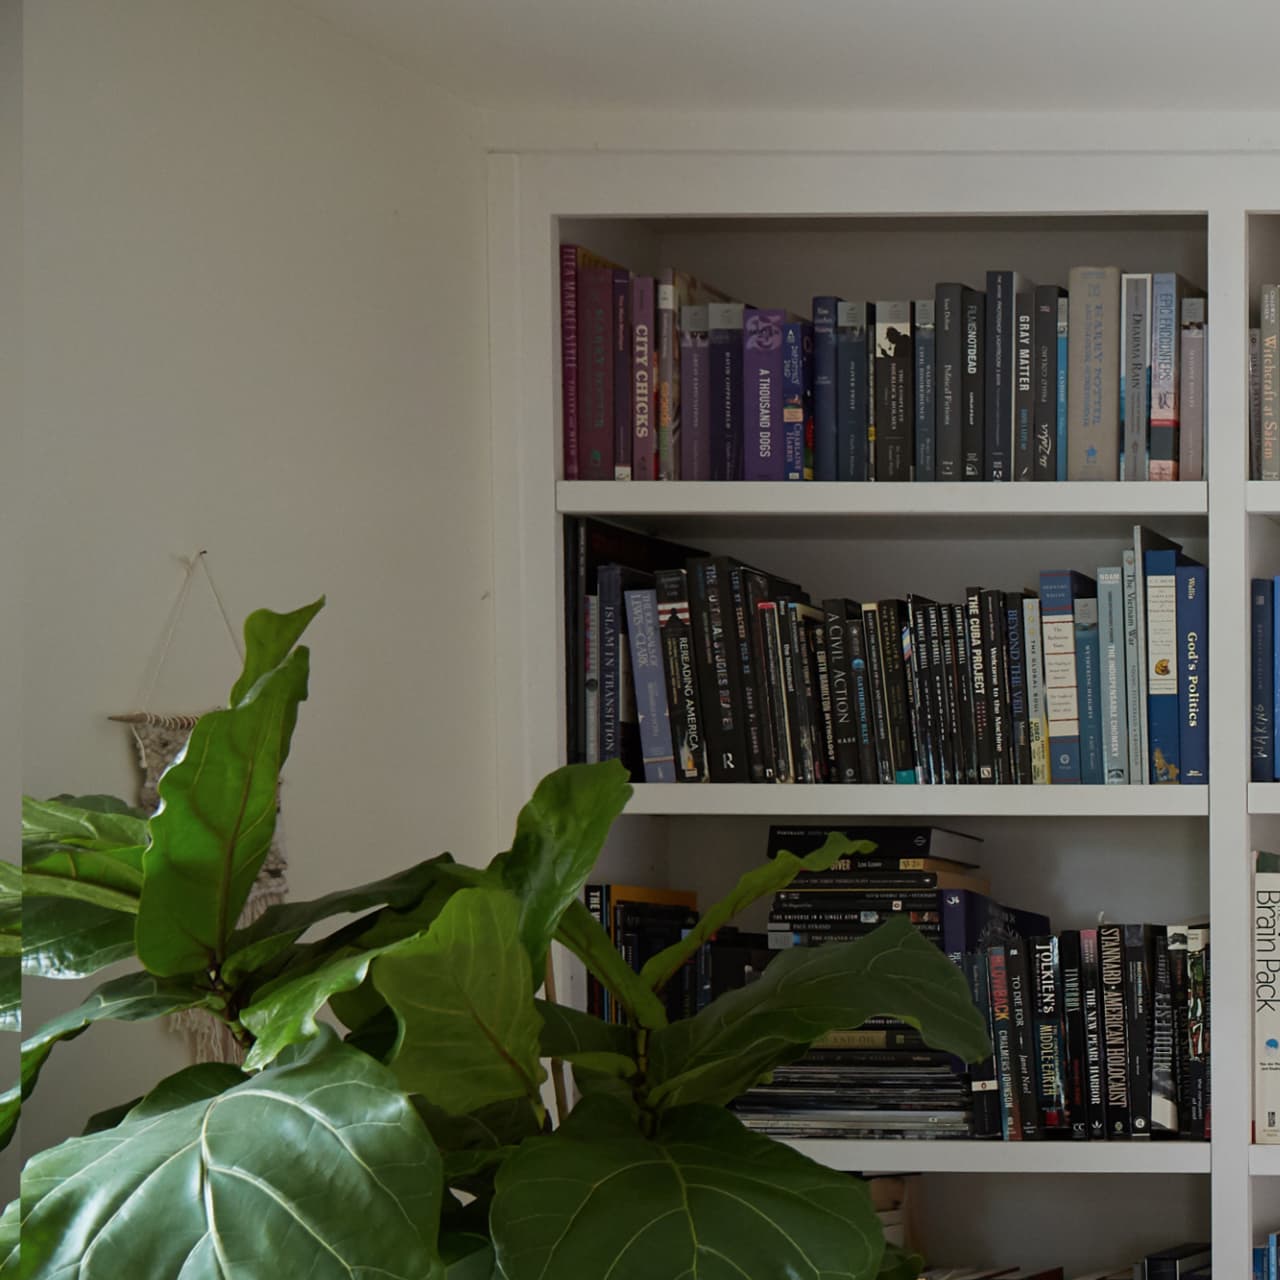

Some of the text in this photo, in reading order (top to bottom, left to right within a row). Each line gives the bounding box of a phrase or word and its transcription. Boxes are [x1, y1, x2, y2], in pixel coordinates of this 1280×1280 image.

[636, 324, 648, 438] CITY CHICKS
[1019, 315, 1030, 391] GRAY MATTER
[1131, 314, 1143, 389] DHARMA RAIN
[1159, 293, 1173, 381] EPIC ENCOUNTERS
[759, 368, 771, 457] A THOUSAND DOGS
[1264, 335, 1277, 458] Witchcraft at Salem
[605, 606, 616, 750] ISLAM IN TRANSITION
[705, 565, 734, 730] THE CULTURAL STUDIES READER
[828, 613, 849, 723] A CIVIL ACTION
[968, 595, 984, 694] THE CUBA PROJECT
[1187, 632, 1198, 727] God's Politics
[679, 637, 699, 751] REREADING AMERICA
[992, 955, 1009, 1021] BLOWBACK
[1038, 943, 1056, 1013] TOLKIEN'S
[1101, 928, 1127, 1108] STANNARD AMERICAN HOLOCAUST
[999, 1030, 1013, 1108] CHALMERS JOHNSON
[1041, 1025, 1056, 1096] MIDDLE-EARTH
